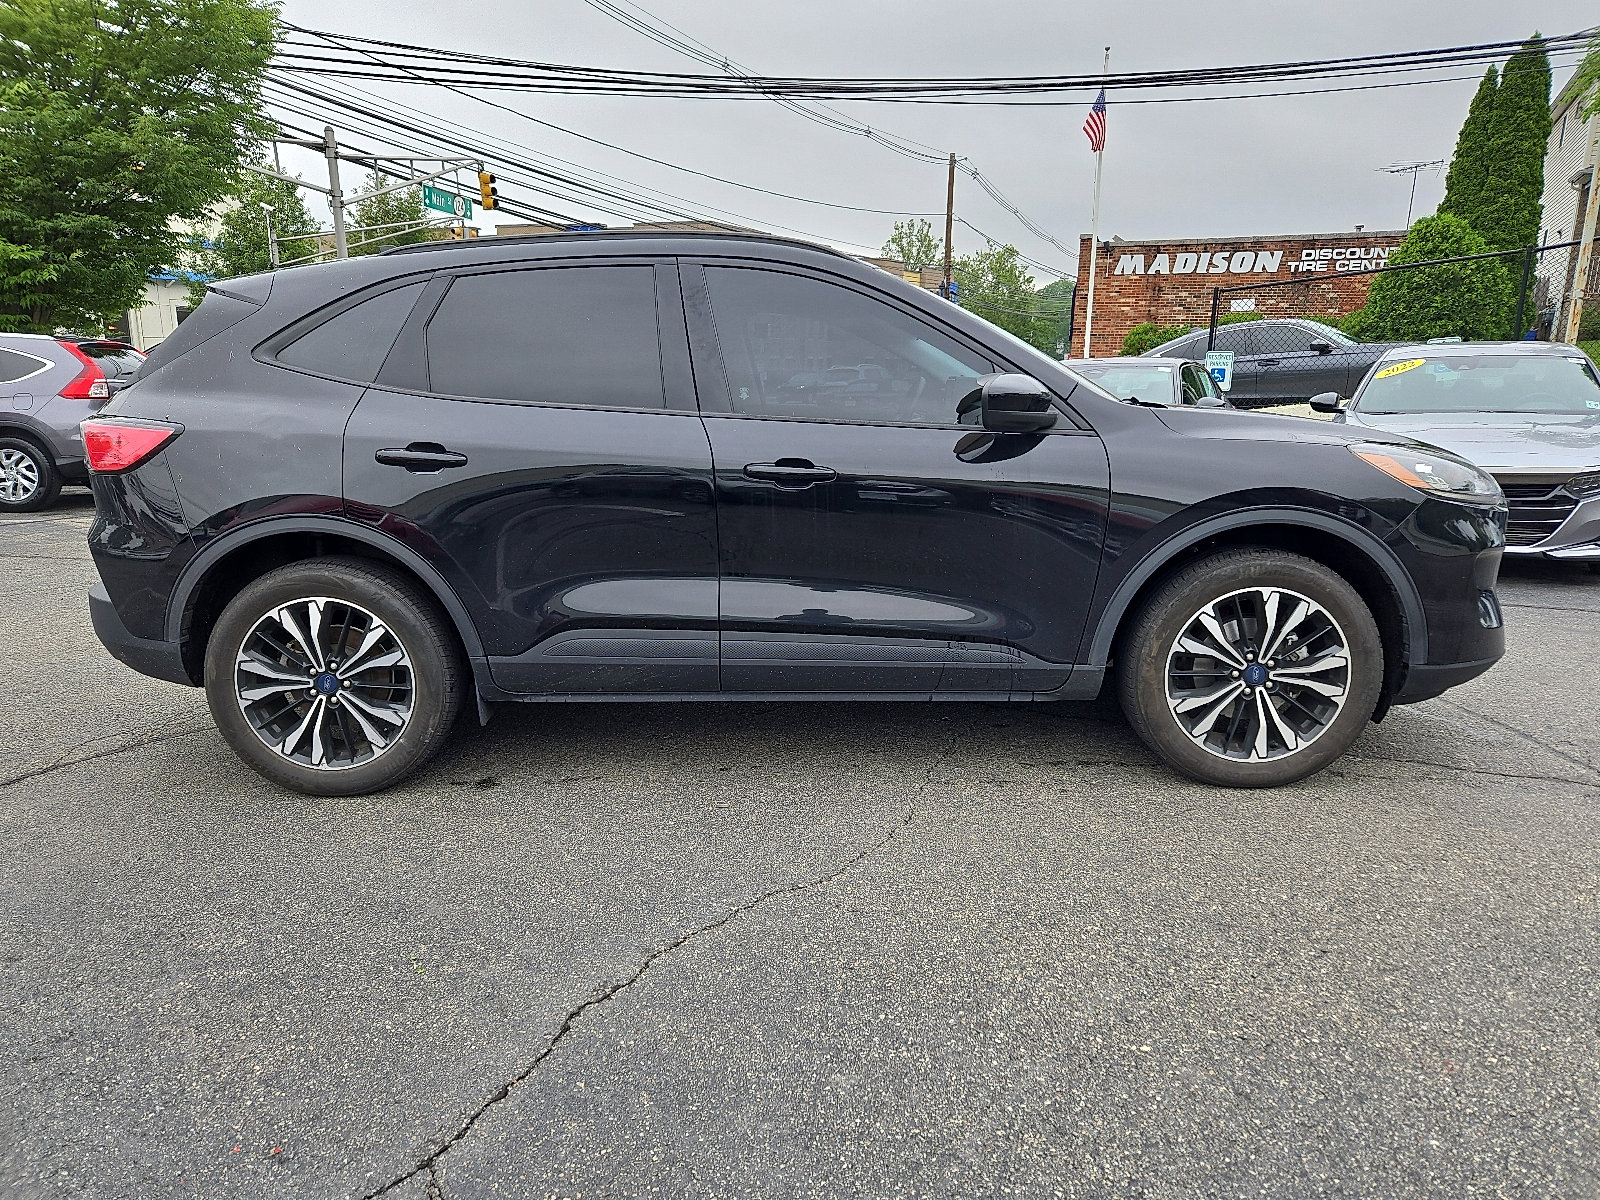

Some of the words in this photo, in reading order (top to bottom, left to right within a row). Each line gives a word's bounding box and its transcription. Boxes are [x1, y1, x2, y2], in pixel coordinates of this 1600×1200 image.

[1113, 251, 1283, 275] MADISON
[1287, 260, 1328, 273] TIRE
[1384, 361, 1416, 376] 2022
